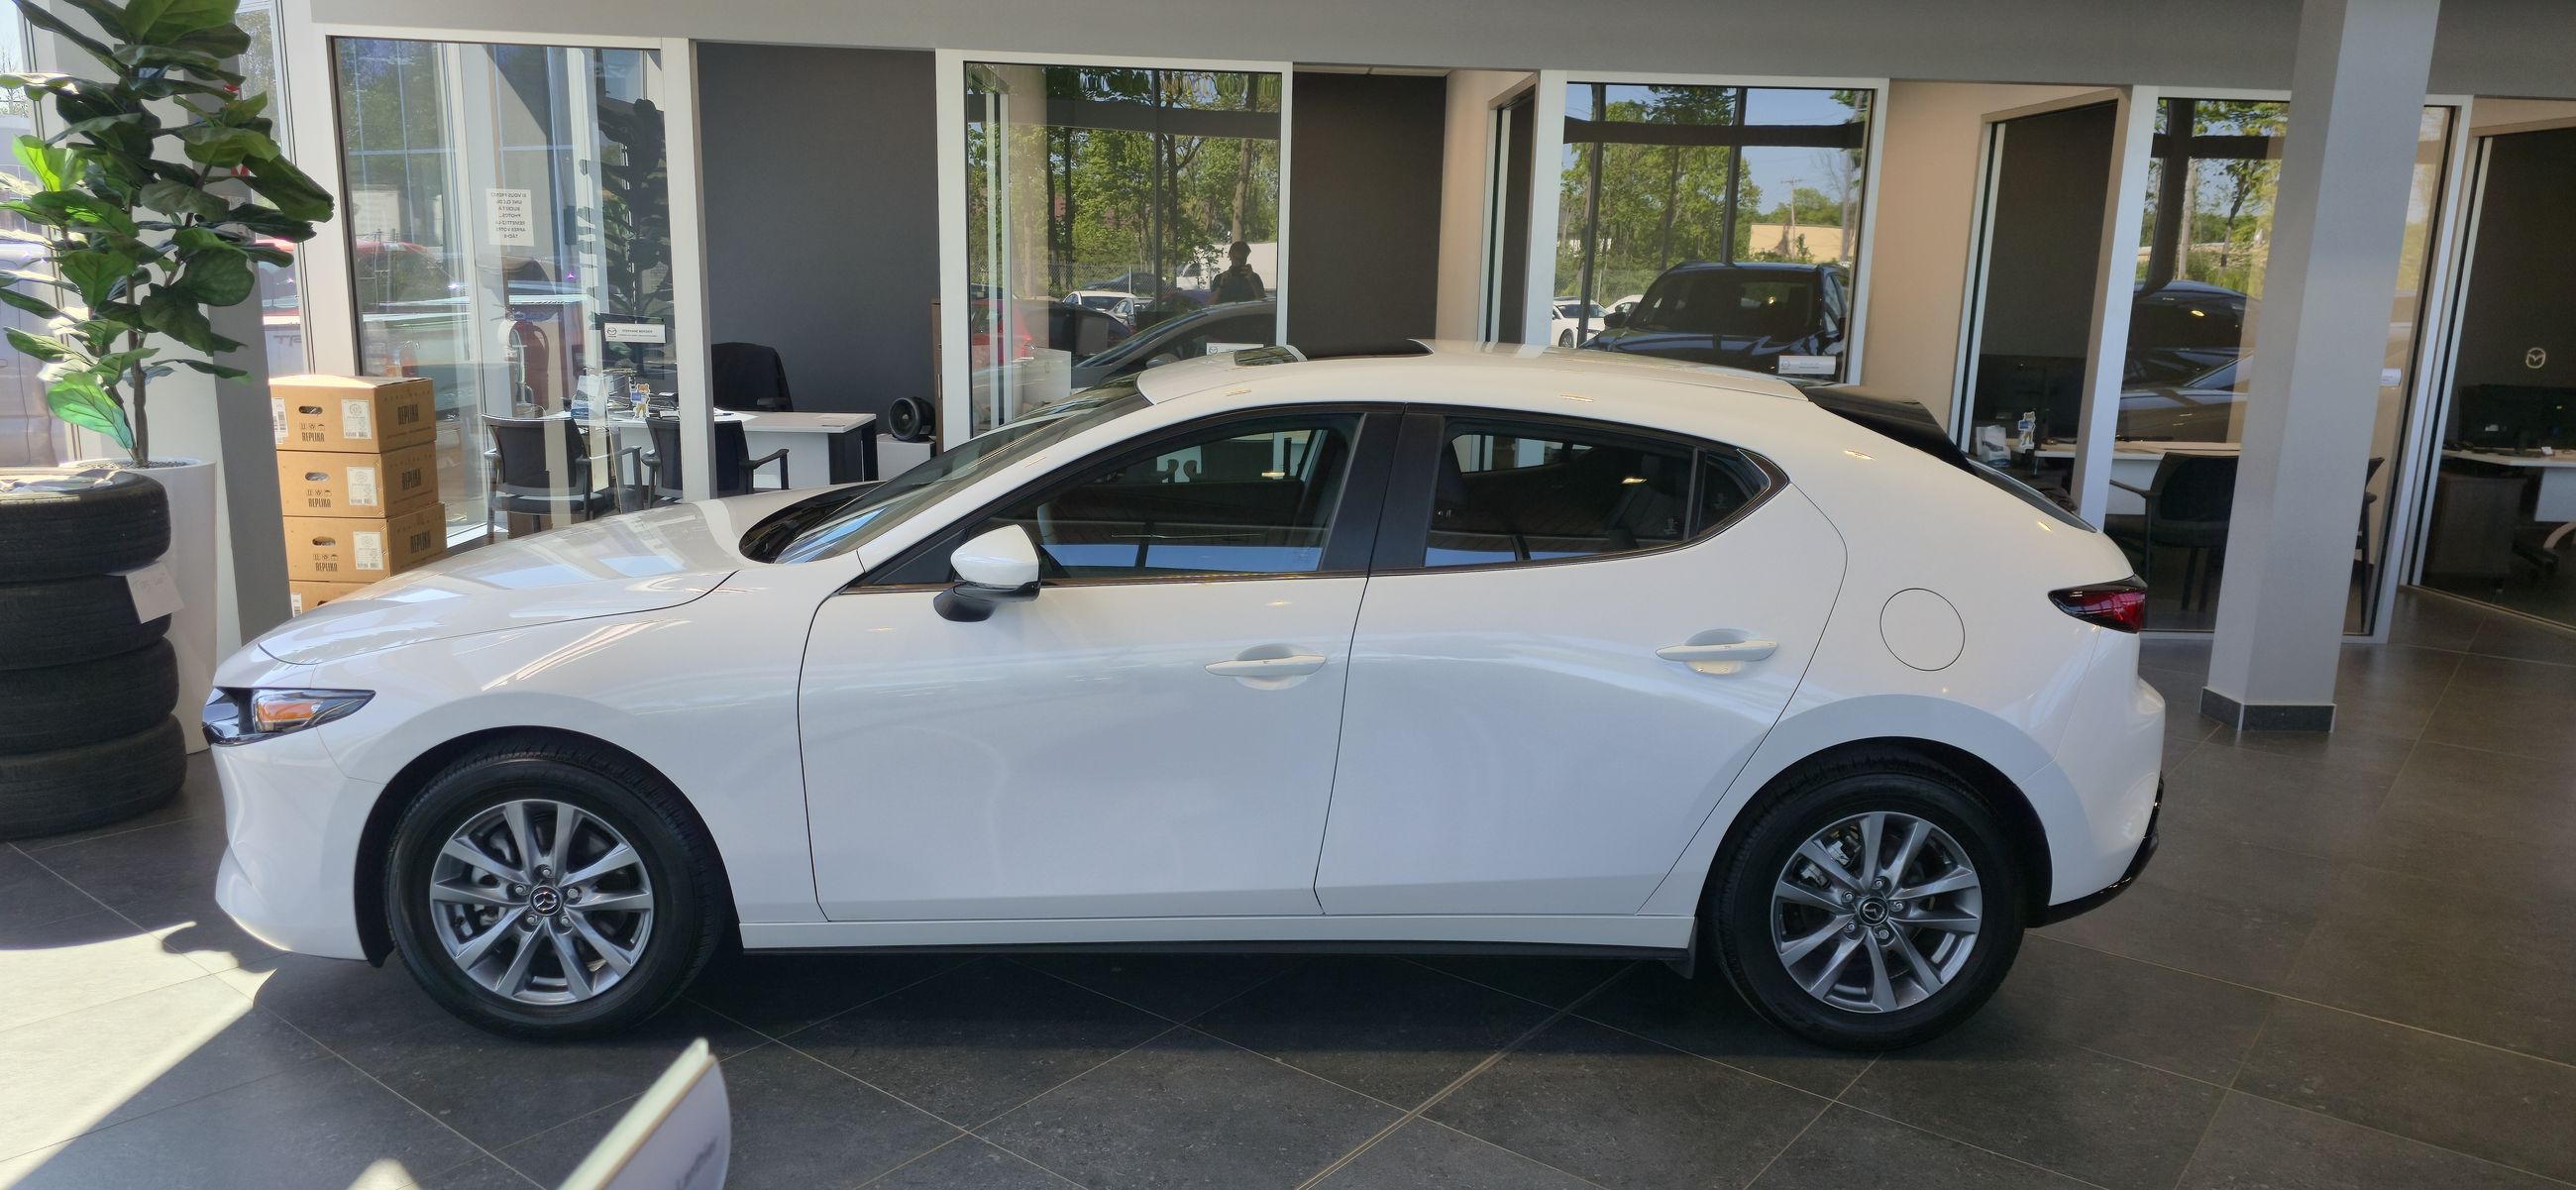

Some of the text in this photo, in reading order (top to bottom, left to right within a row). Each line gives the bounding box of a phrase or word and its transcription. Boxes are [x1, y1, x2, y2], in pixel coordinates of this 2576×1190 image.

[301, 432, 325, 442] REPLIKA
[308, 498, 332, 508] REPLIKA
[315, 562, 338, 572] REPLIKA
